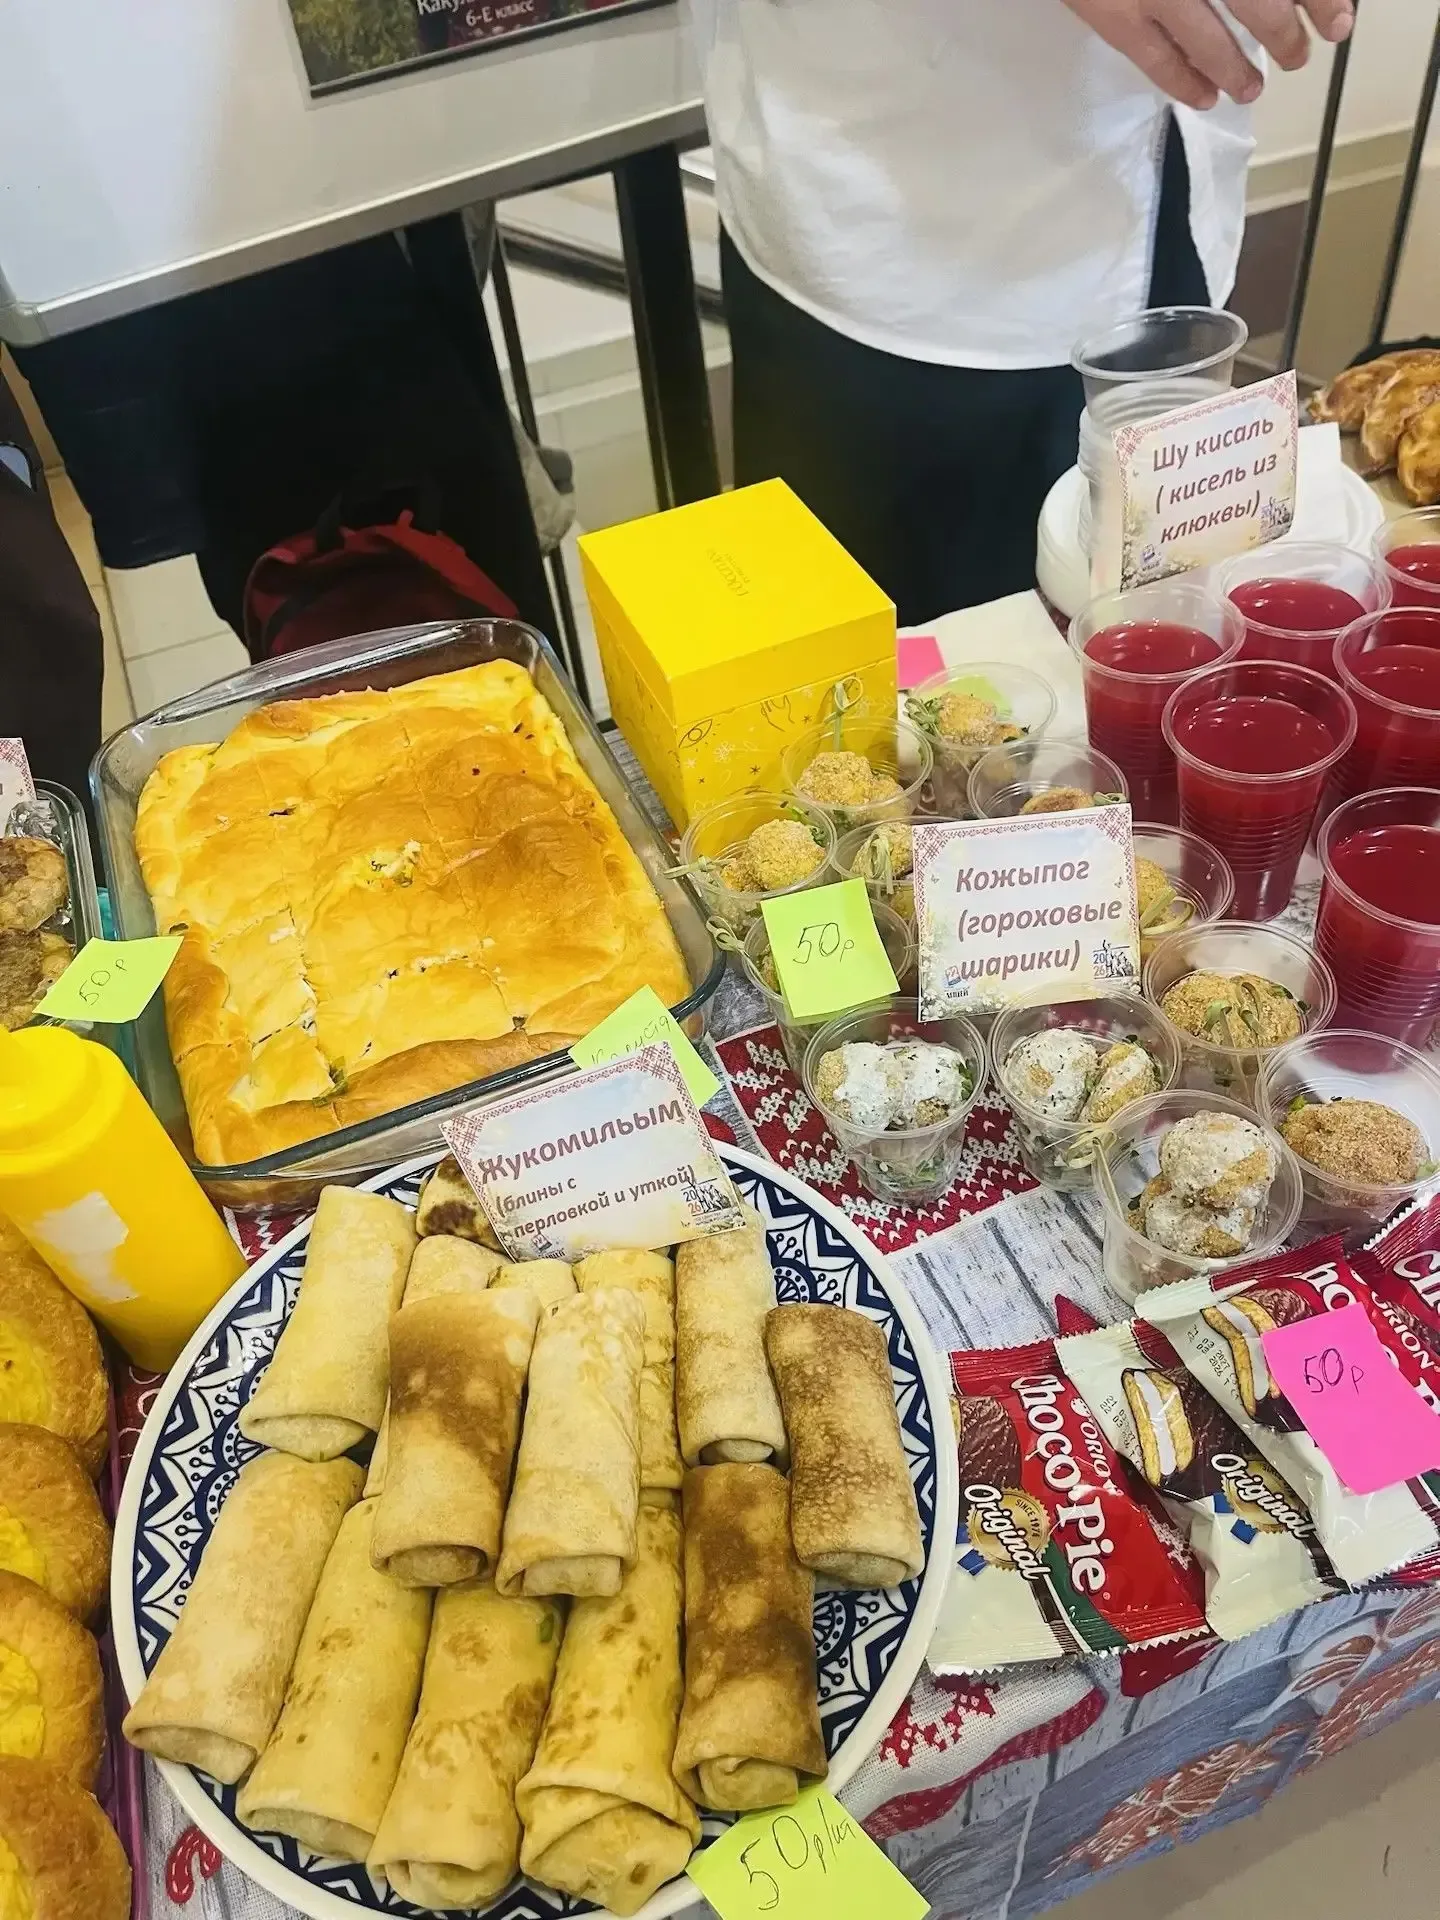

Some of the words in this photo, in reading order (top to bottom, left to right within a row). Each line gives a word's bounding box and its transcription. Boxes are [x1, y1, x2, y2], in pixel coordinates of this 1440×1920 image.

[1153, 443, 1189, 472] Шу
[1195, 418, 1274, 458] кисаль
[1253, 453, 1278, 476] из
[1161, 490, 1260, 544] клюквы)
[956, 860, 1090, 893] Кожыпог
[958, 900, 1123, 943] (гороховые
[961, 940, 1081, 980] шарики)
[478, 1099, 684, 1185] Жукомильым
[496, 1182, 563, 1218] (блины
[567, 1178, 577, 1189] с
[514, 1190, 610, 1238] перловкой
[614, 1190, 626, 1203] и
[629, 1164, 696, 1202] уткой)
[683, 1190, 697, 1202] 20
[688, 1202, 701, 1214] 26
[1015, 1499, 1035, 1519] SINCE
[1211, 1453, 1315, 1538] Original
[964, 1484, 1050, 1580] Original
